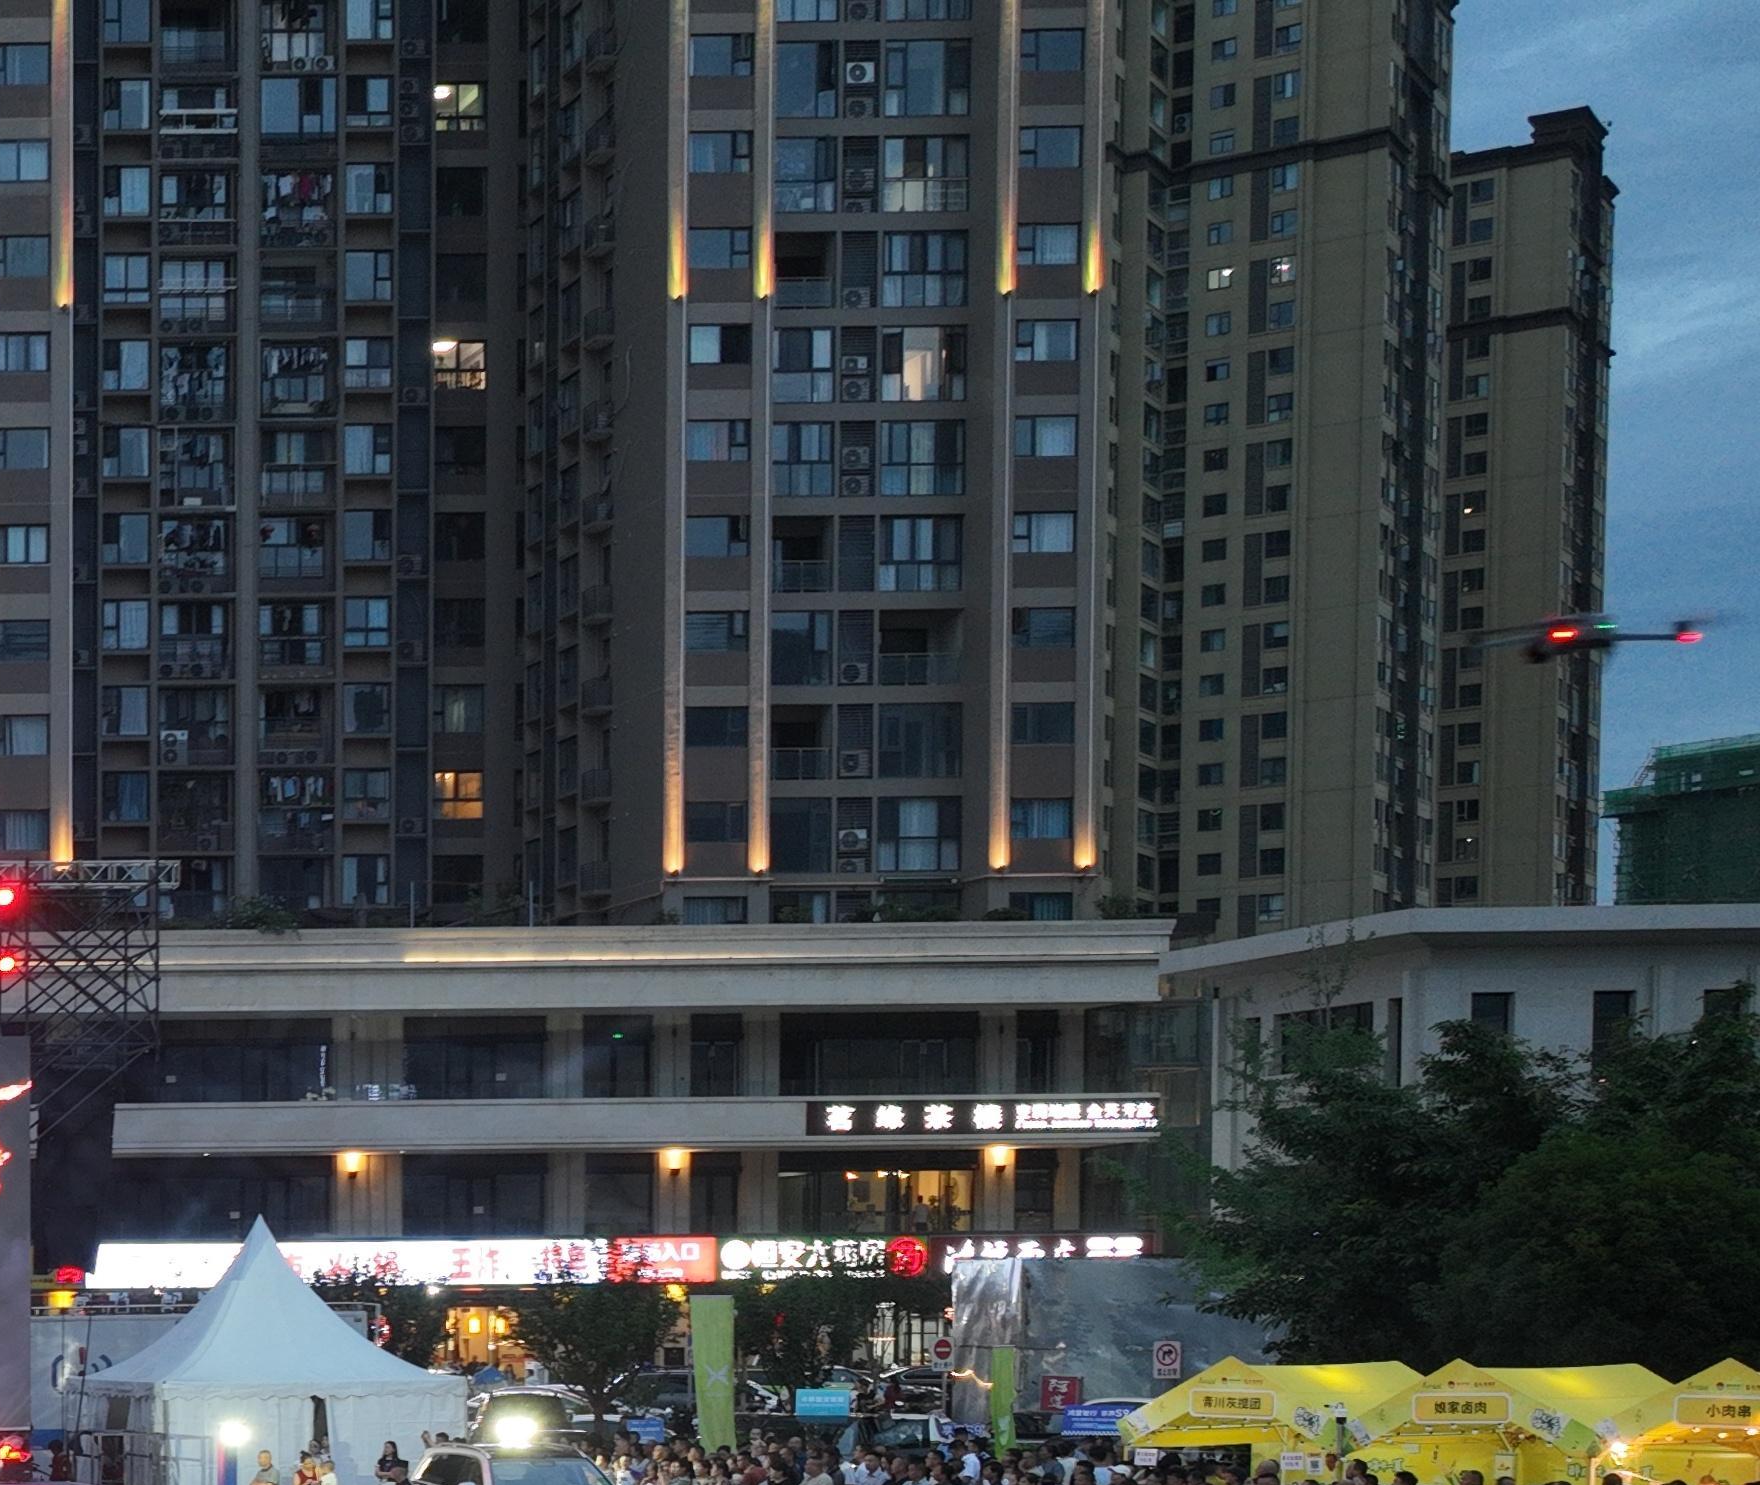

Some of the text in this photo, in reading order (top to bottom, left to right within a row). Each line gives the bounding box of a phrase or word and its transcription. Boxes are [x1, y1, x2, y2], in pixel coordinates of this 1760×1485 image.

[1435, 1401, 1487, 1415] 娘家卤肉
[1706, 1404, 1752, 1418] 小肉串
